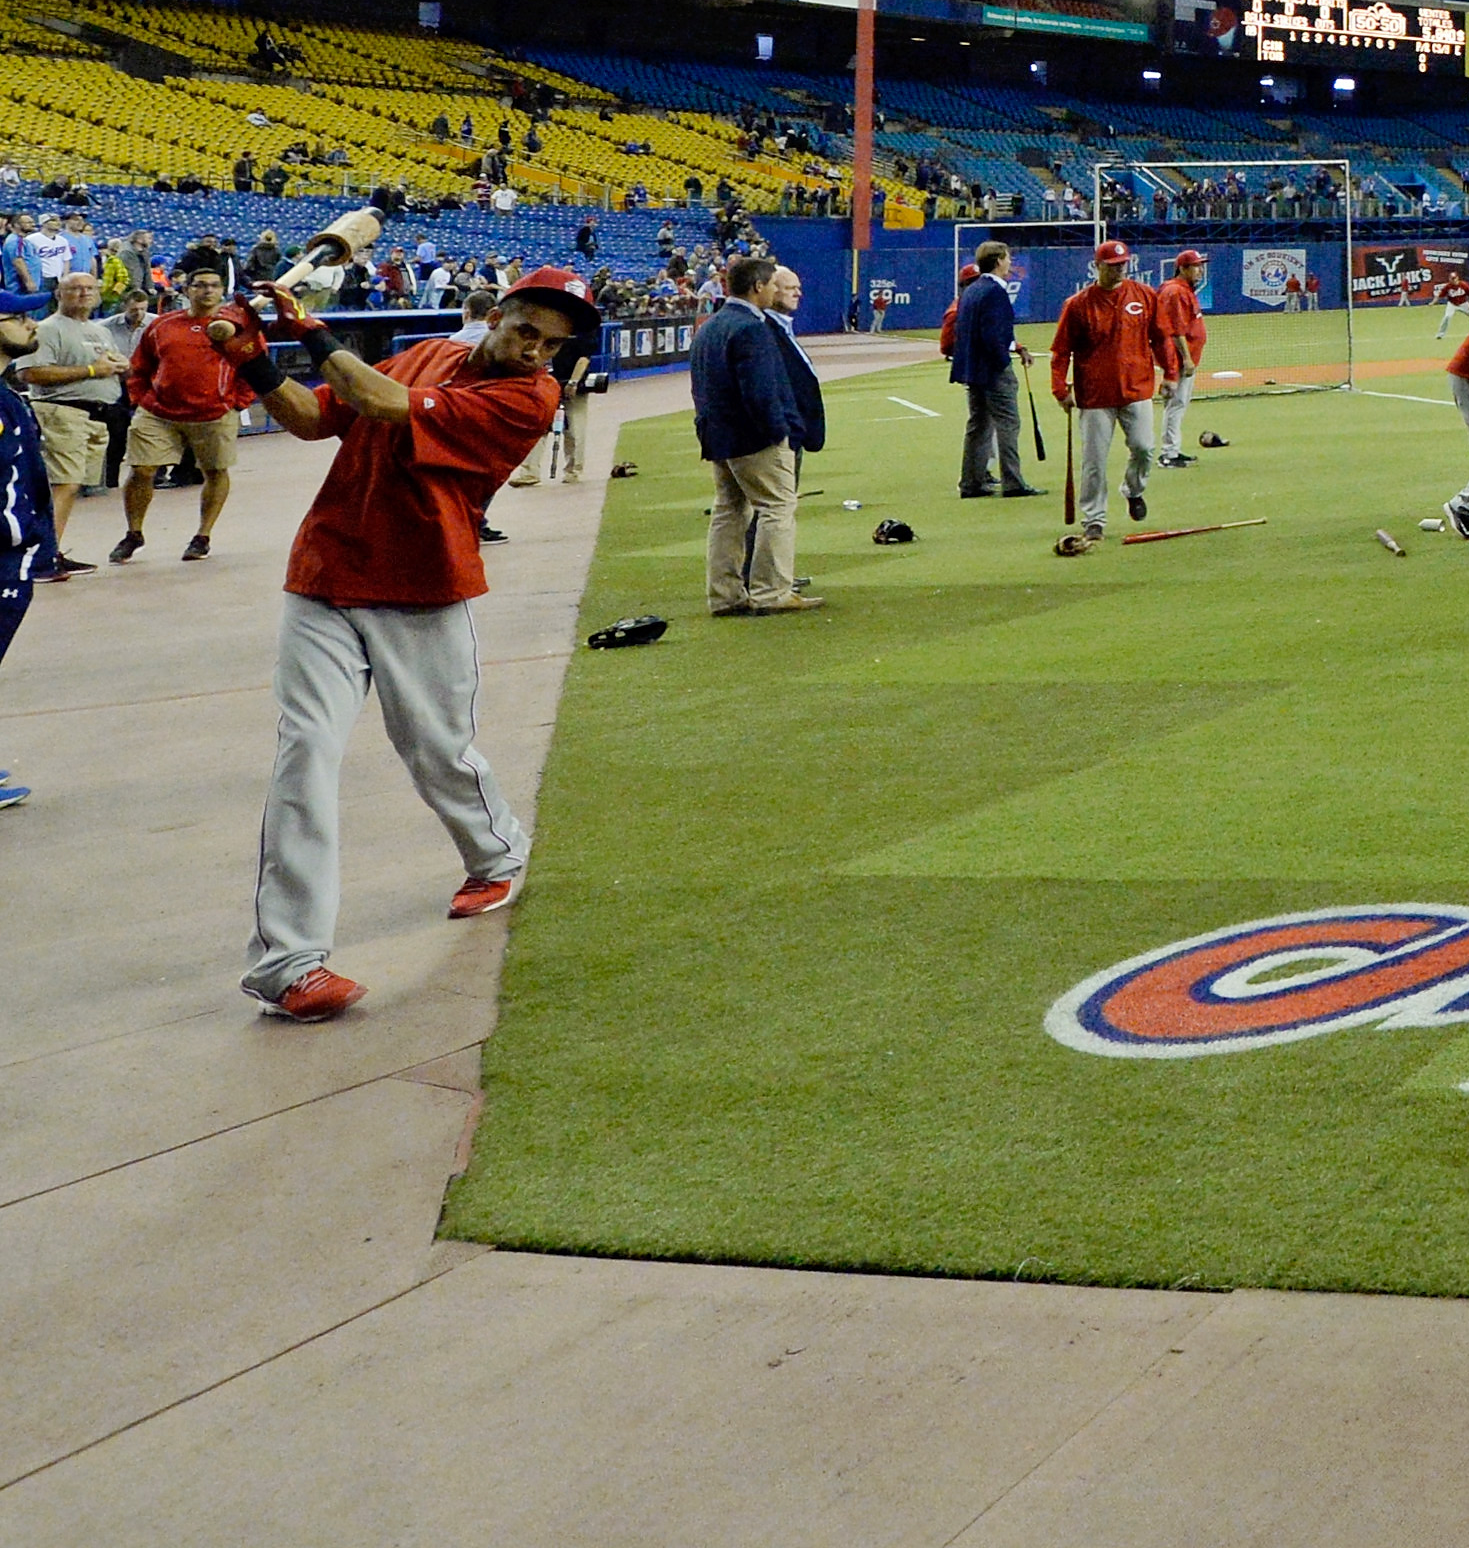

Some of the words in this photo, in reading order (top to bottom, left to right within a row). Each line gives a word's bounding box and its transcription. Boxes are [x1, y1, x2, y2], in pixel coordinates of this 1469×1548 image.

[1356, 16, 1399, 32] 50-50
[1417, 17, 1453, 28] TOTALES
[1289, 31, 1296, 41] 1
[1301, 32, 1310, 42] 2
[1314, 33, 1322, 43] 3
[1327, 34, 1335, 44] 4
[1339, 35, 1348, 46] 5
[1351, 36, 1360, 47] 6
[1364, 37, 1372, 48] 7
[1376, 38, 1384, 49] 8
[1387, 39, 1396, 50] 9
[1352, 275, 1386, 292] JACK
